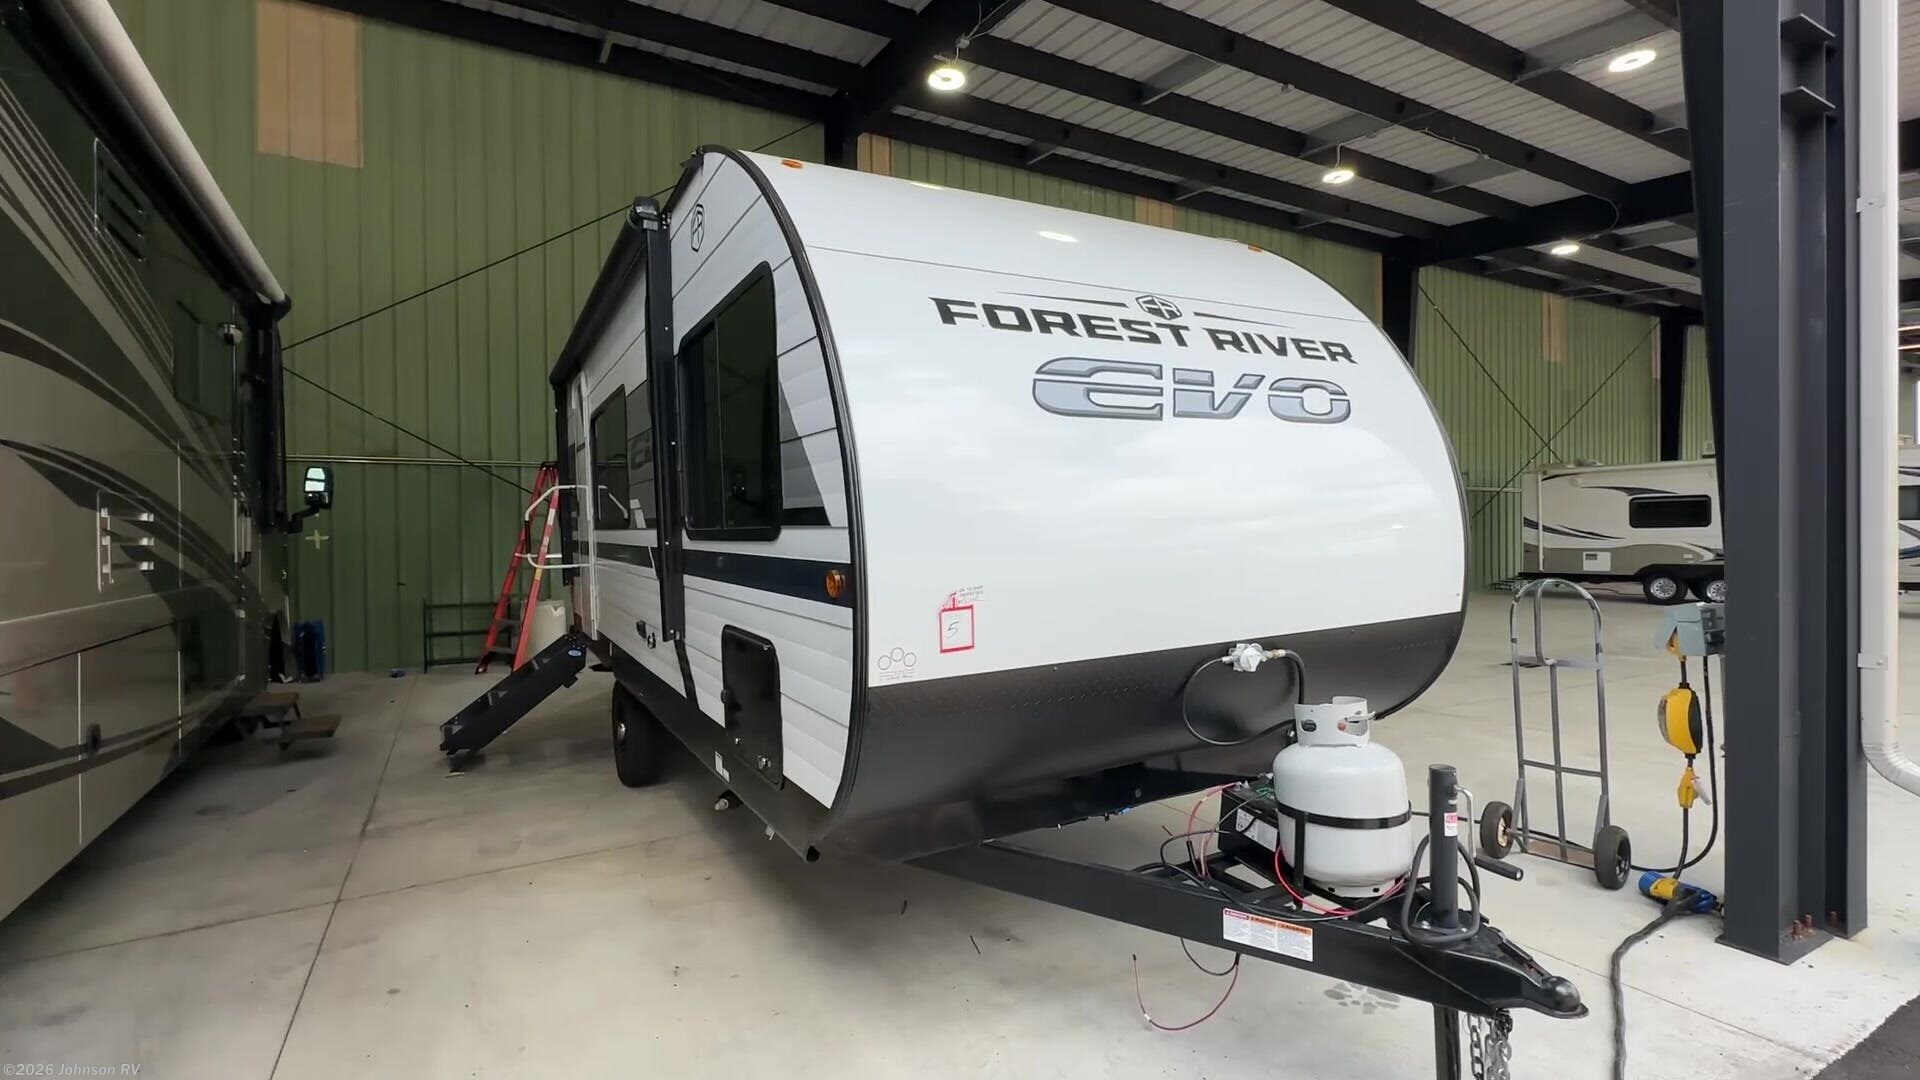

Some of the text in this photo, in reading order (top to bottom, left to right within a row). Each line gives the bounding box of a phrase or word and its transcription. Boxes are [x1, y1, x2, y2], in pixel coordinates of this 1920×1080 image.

[928, 296, 1358, 364] FOREST RIVER
[1032, 356, 1352, 424] EVO
